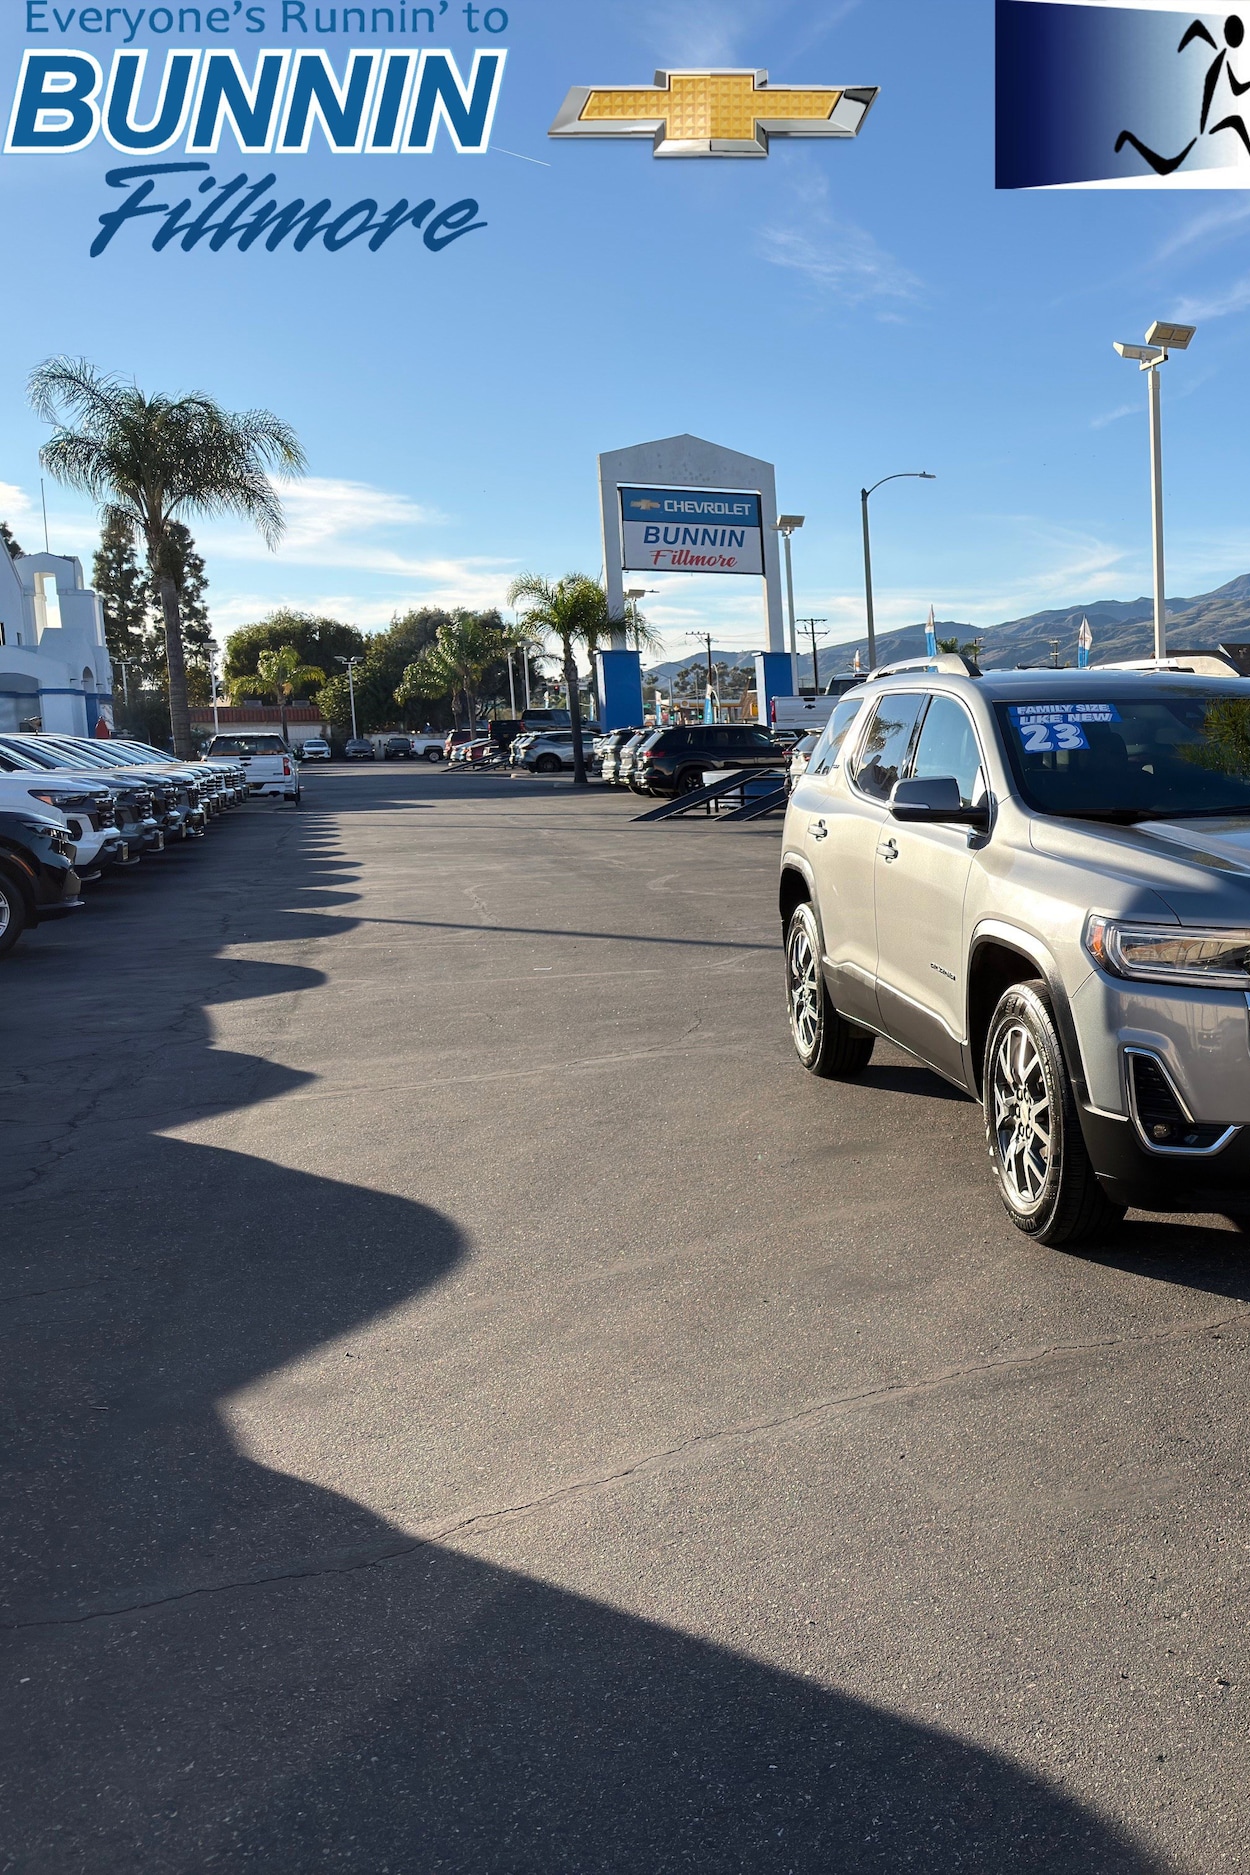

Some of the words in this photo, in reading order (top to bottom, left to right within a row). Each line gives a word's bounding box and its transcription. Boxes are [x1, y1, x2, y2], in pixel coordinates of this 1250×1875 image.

[664, 500, 751, 516] CHEVROLET
[643, 526, 745, 548] BUNNIN
[650, 550, 738, 568] Fillmore
[1017, 704, 1072, 715] FAMILY
[1076, 704, 1111, 713] SIZE
[1020, 714, 1063, 725] LIKE
[1068, 713, 1112, 723] NEW
[1020, 723, 1084, 751] 23
